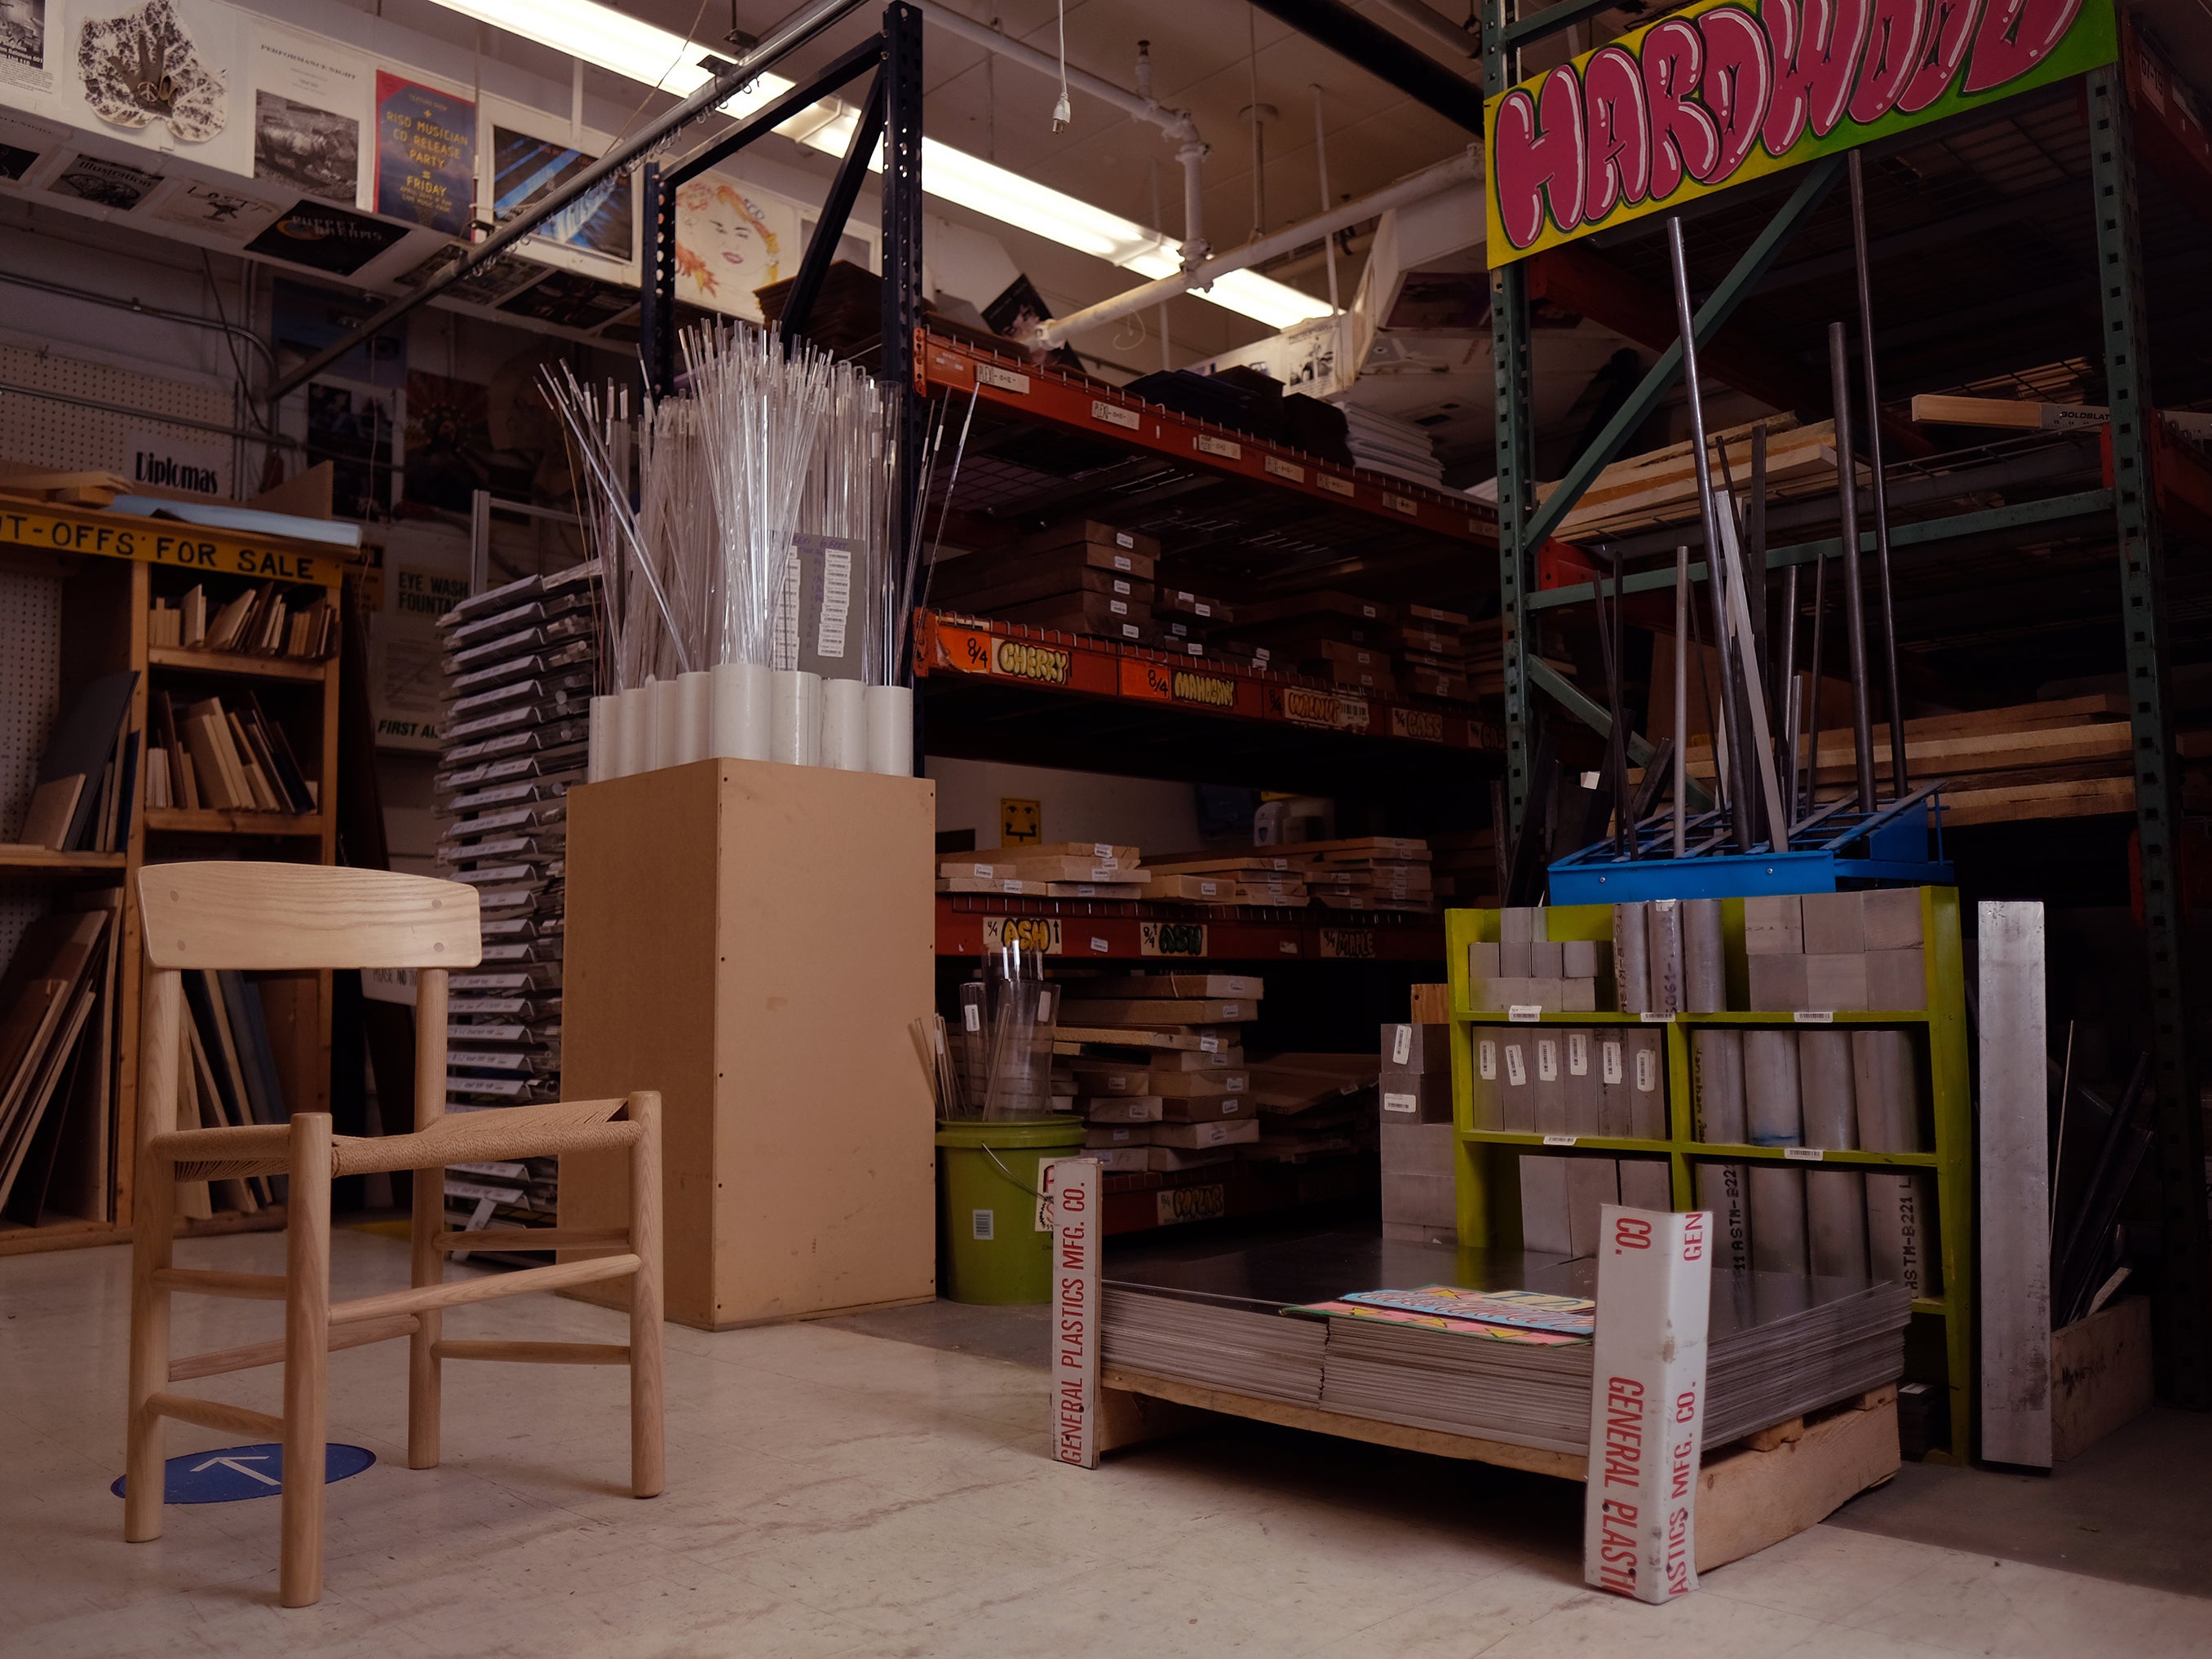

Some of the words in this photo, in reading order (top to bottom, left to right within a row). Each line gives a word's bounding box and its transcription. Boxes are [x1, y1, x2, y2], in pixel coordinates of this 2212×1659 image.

[393, 128, 408, 143] CD
[414, 134, 462, 160] RELEASE
[417, 121, 469, 146] MUSICIAN
[1496, 0, 2085, 250] HARDWOOD
[409, 148, 445, 170] PARTY
[406, 175, 447, 197] FRIDAY
[135, 450, 219, 495] Diplomas
[0, 515, 135, 555] T-OFFS
[156, 536, 219, 568] FOR
[237, 548, 315, 581] SALE
[398, 571, 424, 592] EYE
[430, 576, 469, 599] WASH
[967, 638, 989, 668] 8/4
[998, 639, 1068, 685] CHERRY
[1148, 669, 1169, 697] 8/4
[1174, 670, 1236, 709] MAHOGANY
[1289, 692, 1341, 724] WALNUT
[378, 719, 419, 737] FIRST
[420, 723, 440, 739] AI
[1001, 918, 1051, 953] ASH
[1143, 926, 1156, 949] 8/4
[1158, 922, 1203, 956] ASH
[1335, 930, 1374, 957] MAPLE
[1062, 1182, 1086, 1213] CO.
[1172, 1186, 1224, 1219] POPLAR
[1723, 1165, 1745, 1252] ASTM-B22
[1062, 1221, 1086, 1271] MFG.
[1614, 1217, 1652, 1256] CO.
[1060, 1276, 1085, 1370] PLASTICS
[1060, 1378, 1084, 1465] GENERAL
[1675, 1380, 1697, 1424] CO.
[1604, 1376, 1645, 1489] GENERAL
[1670, 1433, 1693, 1501] MFG.
